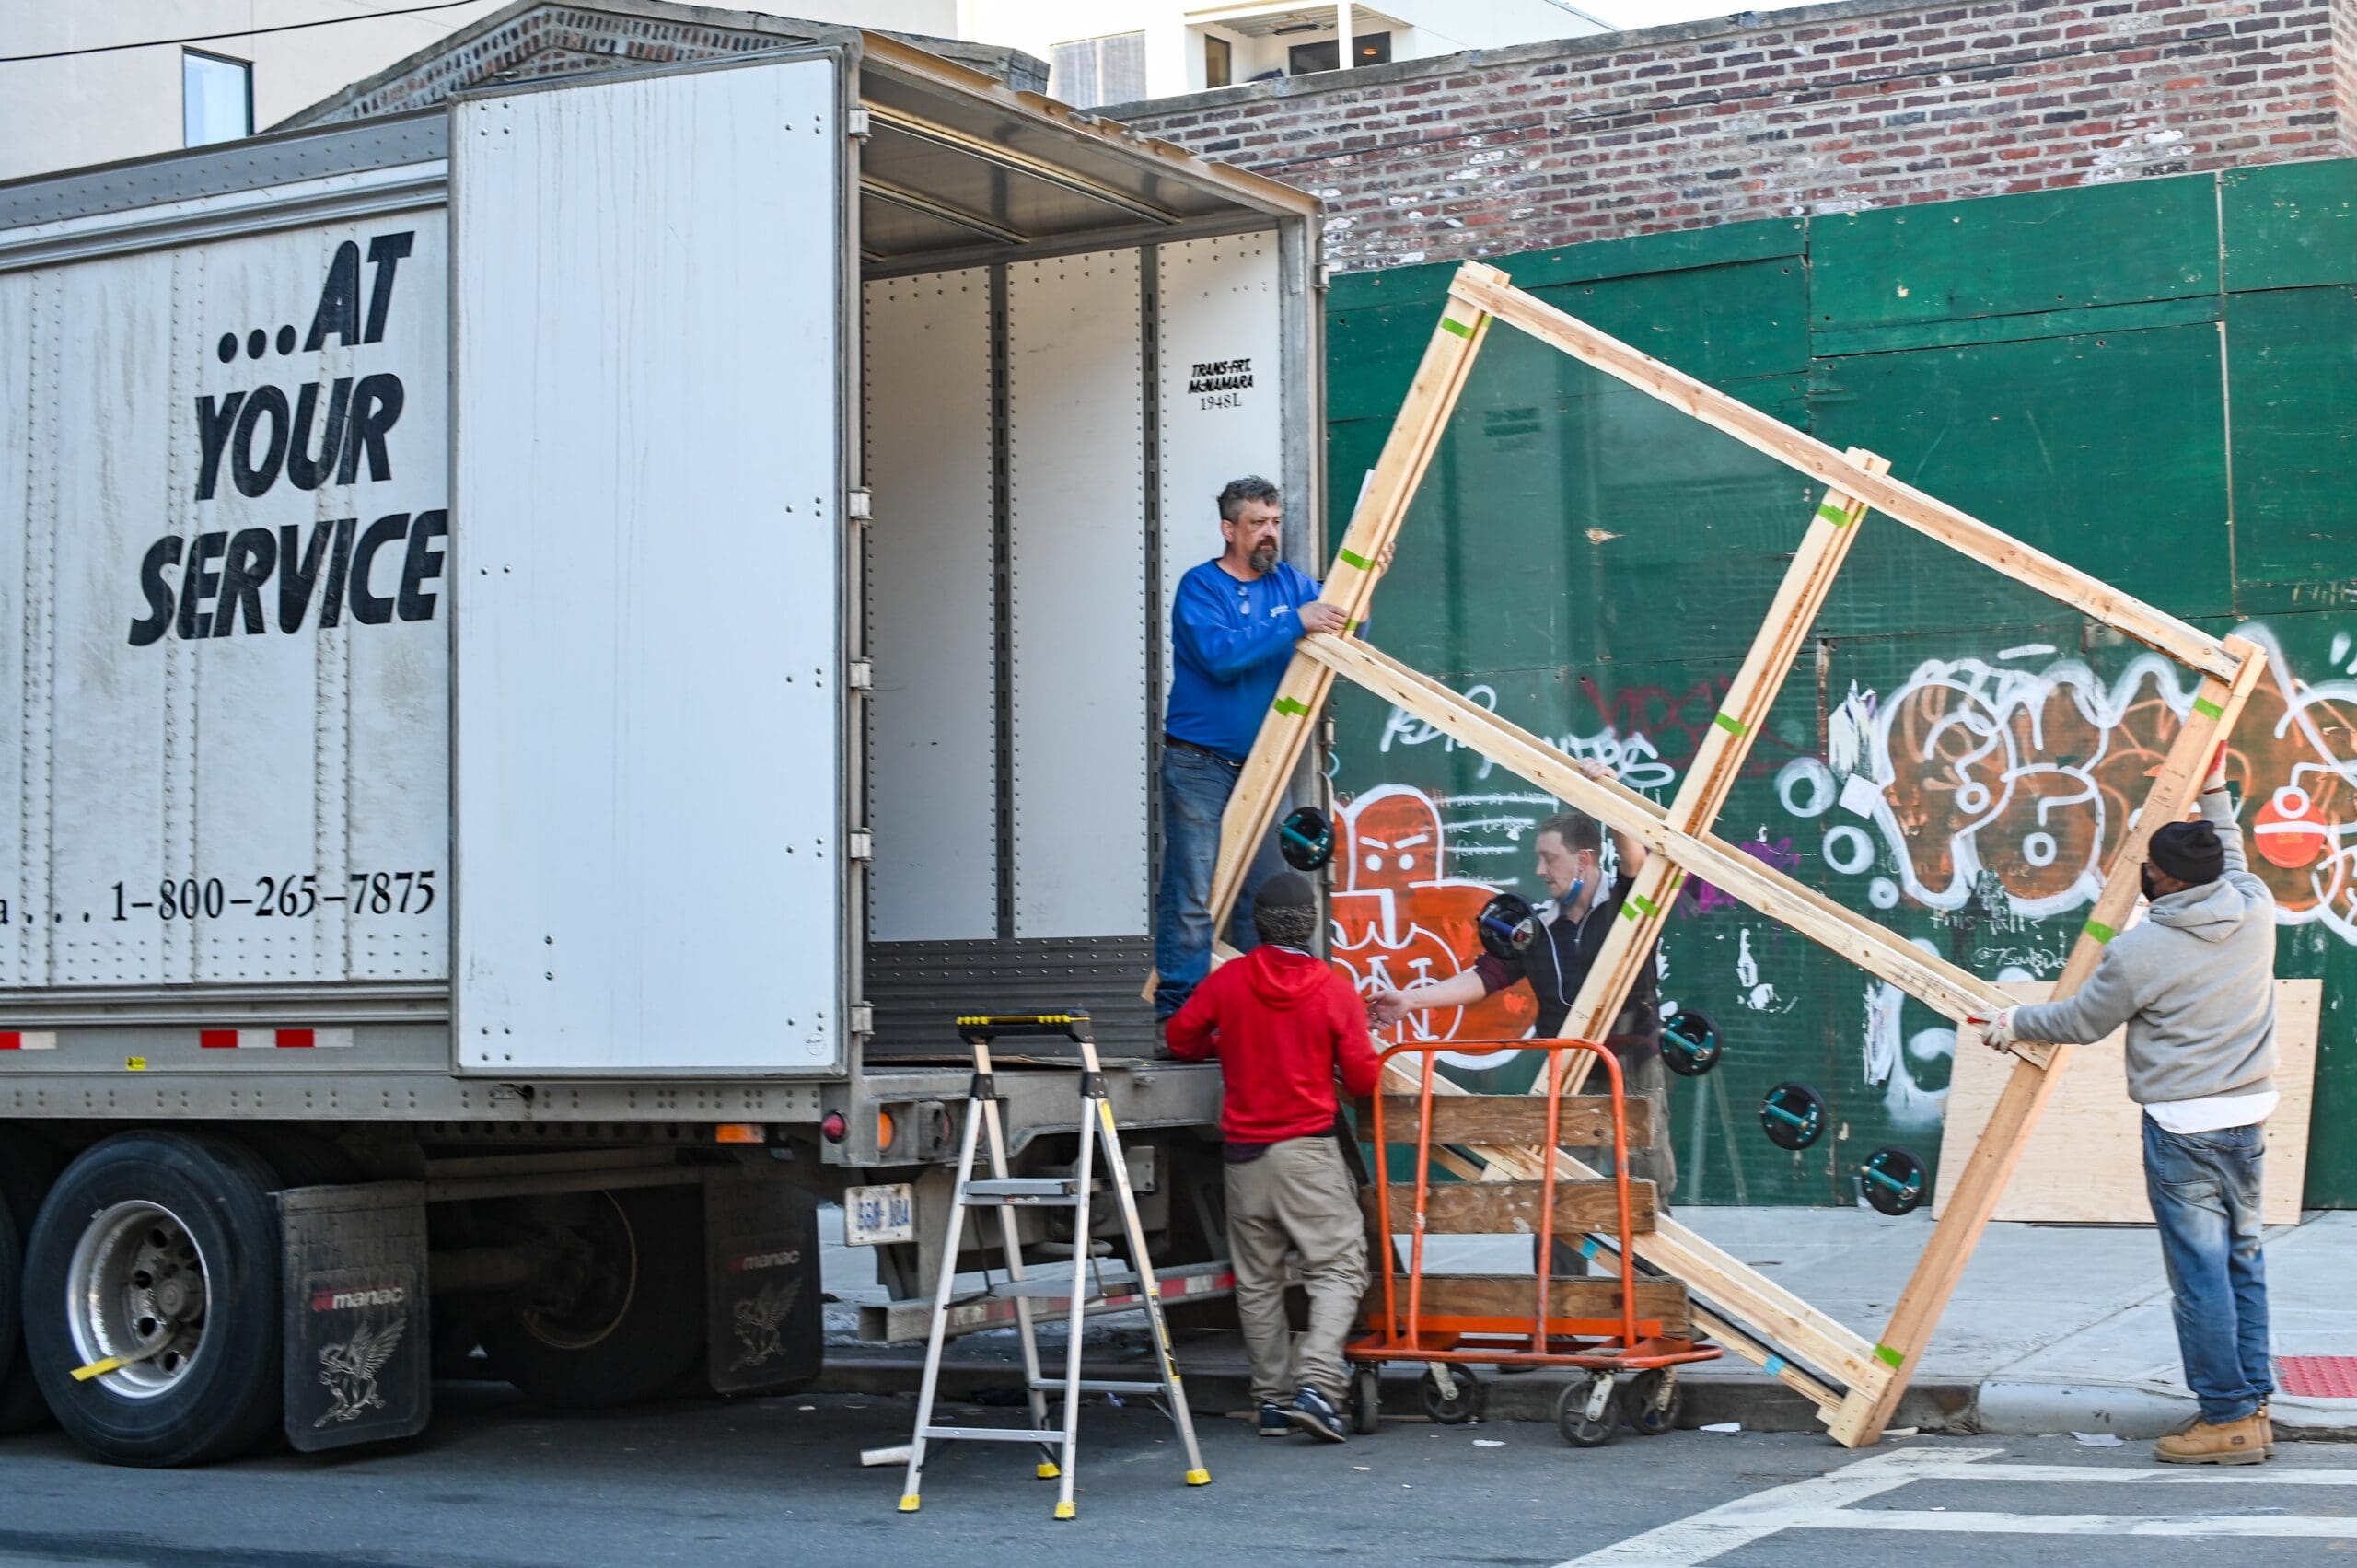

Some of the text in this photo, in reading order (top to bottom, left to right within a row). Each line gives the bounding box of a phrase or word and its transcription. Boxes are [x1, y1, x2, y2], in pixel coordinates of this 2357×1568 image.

[195, 373, 404, 501] YOUR
[128, 509, 448, 646] SERVICE
[110, 870, 435, 921] 1-800-265-7875
[331, 1287, 405, 1310] manac
